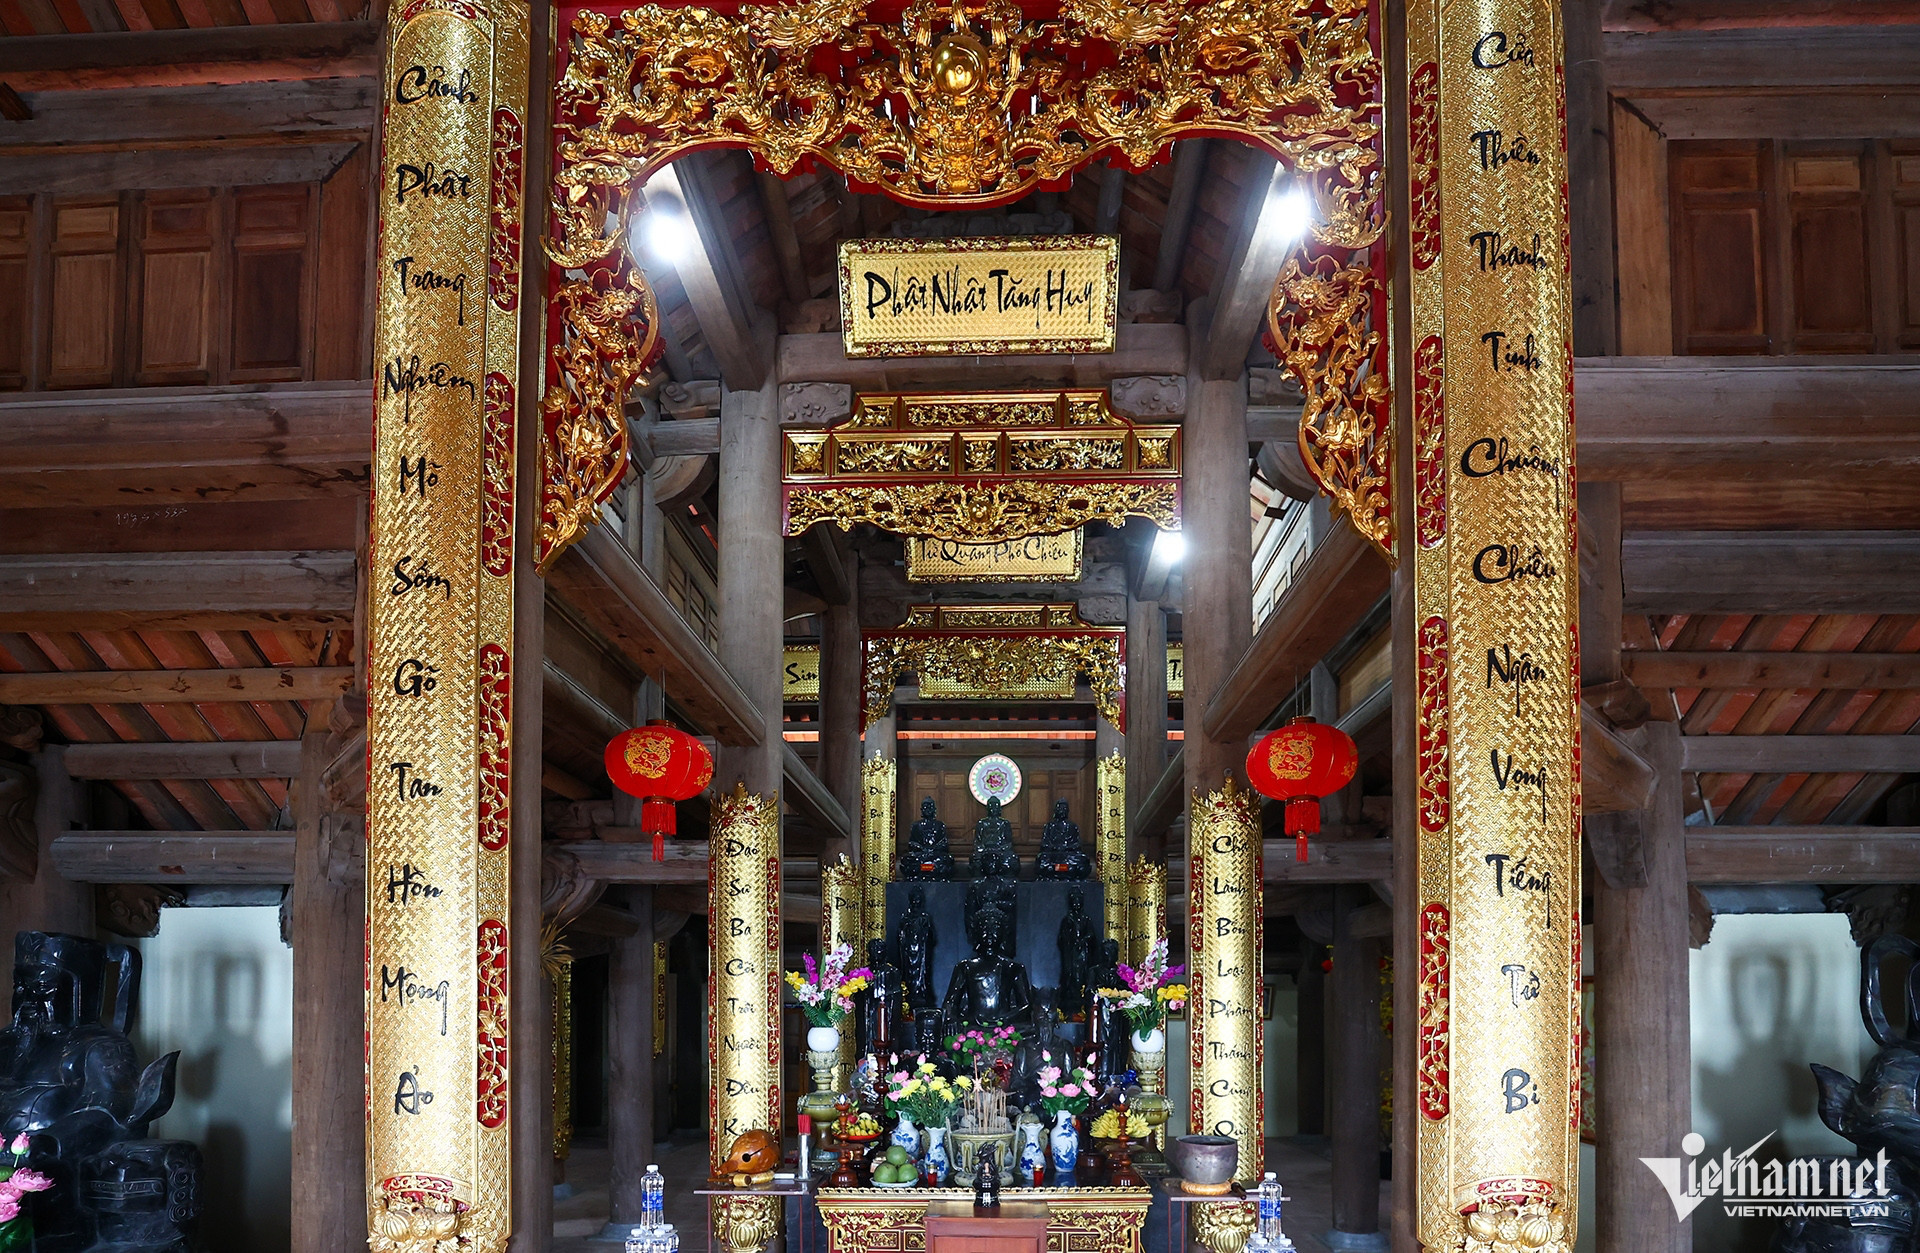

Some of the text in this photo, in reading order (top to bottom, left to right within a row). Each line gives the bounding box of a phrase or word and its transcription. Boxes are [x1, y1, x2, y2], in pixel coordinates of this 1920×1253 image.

[396, 65, 480, 105] Cảnh
[1470, 129, 1541, 171] Thiền
[396, 161, 471, 203] Phật
[1469, 231, 1547, 273] Thanh
[393, 256, 466, 326] Trang
[863, 264, 1093, 329] Phật Nhật Tăng Huy
[1482, 331, 1543, 372] Tịnh
[383, 355, 475, 424] Nghiêm
[399, 454, 443, 497] Mõ
[1461, 436, 1560, 513] Chuông
[940, 539, 991, 568] Quang
[1473, 544, 1556, 584] Chiều
[393, 658, 439, 698] Gõ
[1486, 643, 1546, 717] Ngân
[390, 762, 443, 801] Tan
[1491, 749, 1547, 824] Vọng
[724, 839, 759, 858] Đạo
[1213, 836, 1249, 853] Cha
[387, 863, 444, 907] Hồn
[1214, 875, 1247, 894] Lành
[1485, 853, 1552, 929] Tiếng
[730, 917, 751, 937] Ba
[381, 964, 449, 1037] Mộng
[1501, 964, 1540, 1008] Từ
[395, 1065, 434, 1116] Ảo
[725, 1077, 760, 1097] Đều
[1501, 1068, 1540, 1114] Bi
